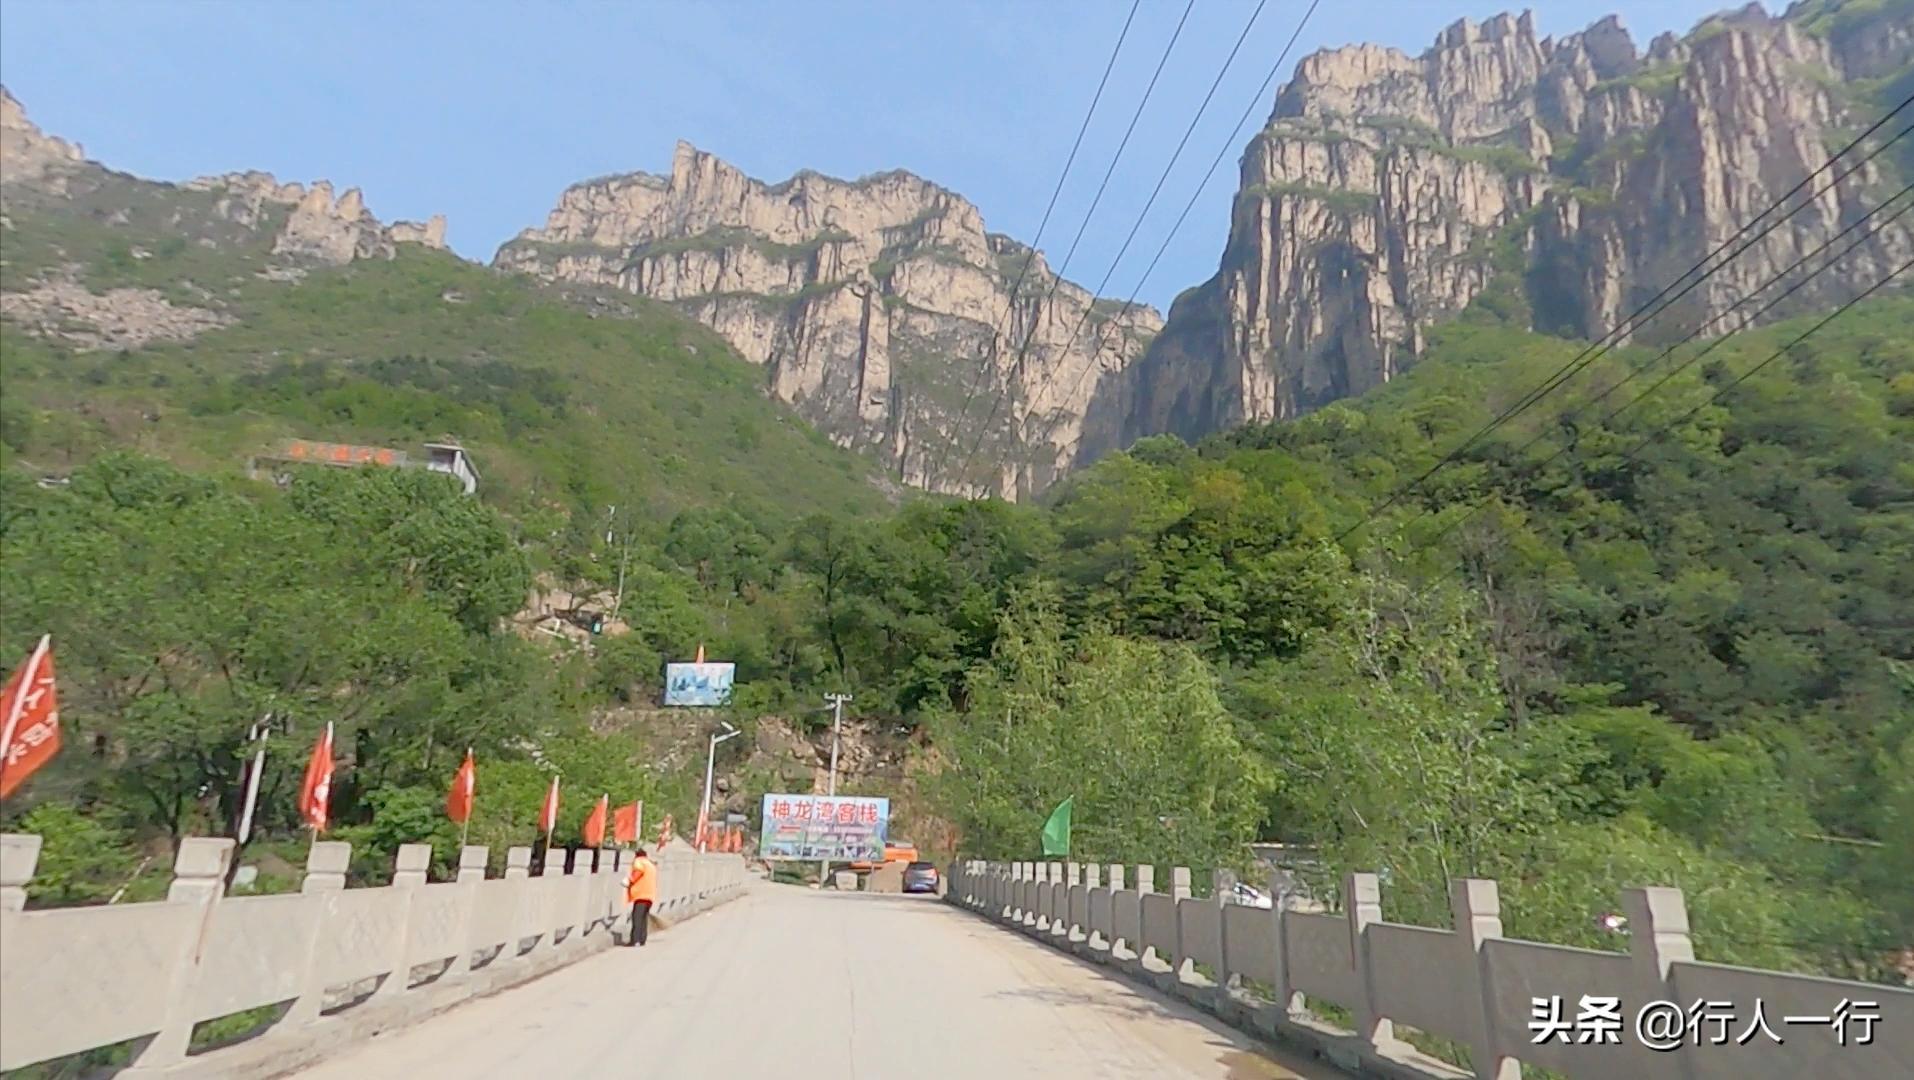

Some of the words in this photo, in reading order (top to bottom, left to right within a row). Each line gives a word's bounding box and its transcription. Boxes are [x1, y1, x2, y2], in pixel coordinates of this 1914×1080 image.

[772, 800, 878, 823] 神龙湾客栈
